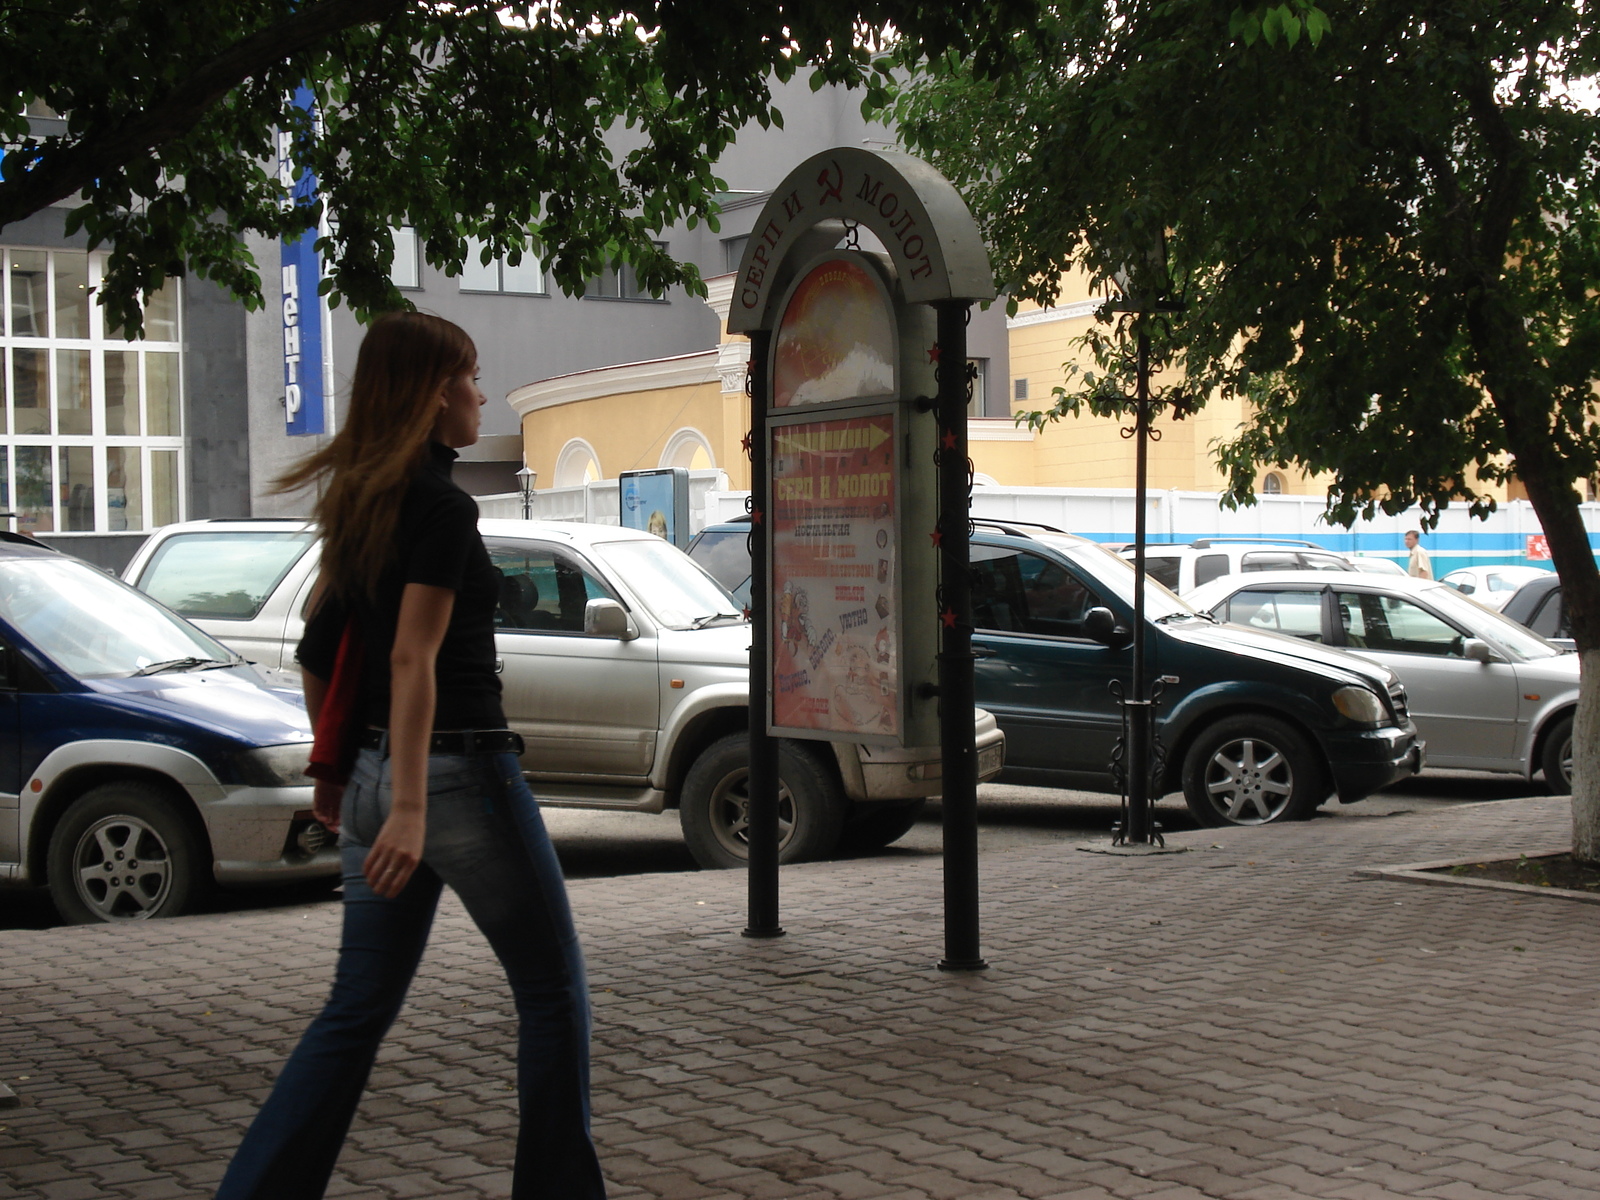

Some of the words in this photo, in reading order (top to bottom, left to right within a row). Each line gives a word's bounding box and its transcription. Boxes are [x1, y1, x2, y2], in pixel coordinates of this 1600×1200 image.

[741, 218, 784, 310] СЕРП
[781, 189, 805, 223] И
[856, 173, 933, 281] МОЛОТ
[282, 264, 301, 424] центр
[777, 476, 814, 501] СЕРП
[820, 475, 831, 499] И
[837, 472, 891, 498] МОЛОТ
